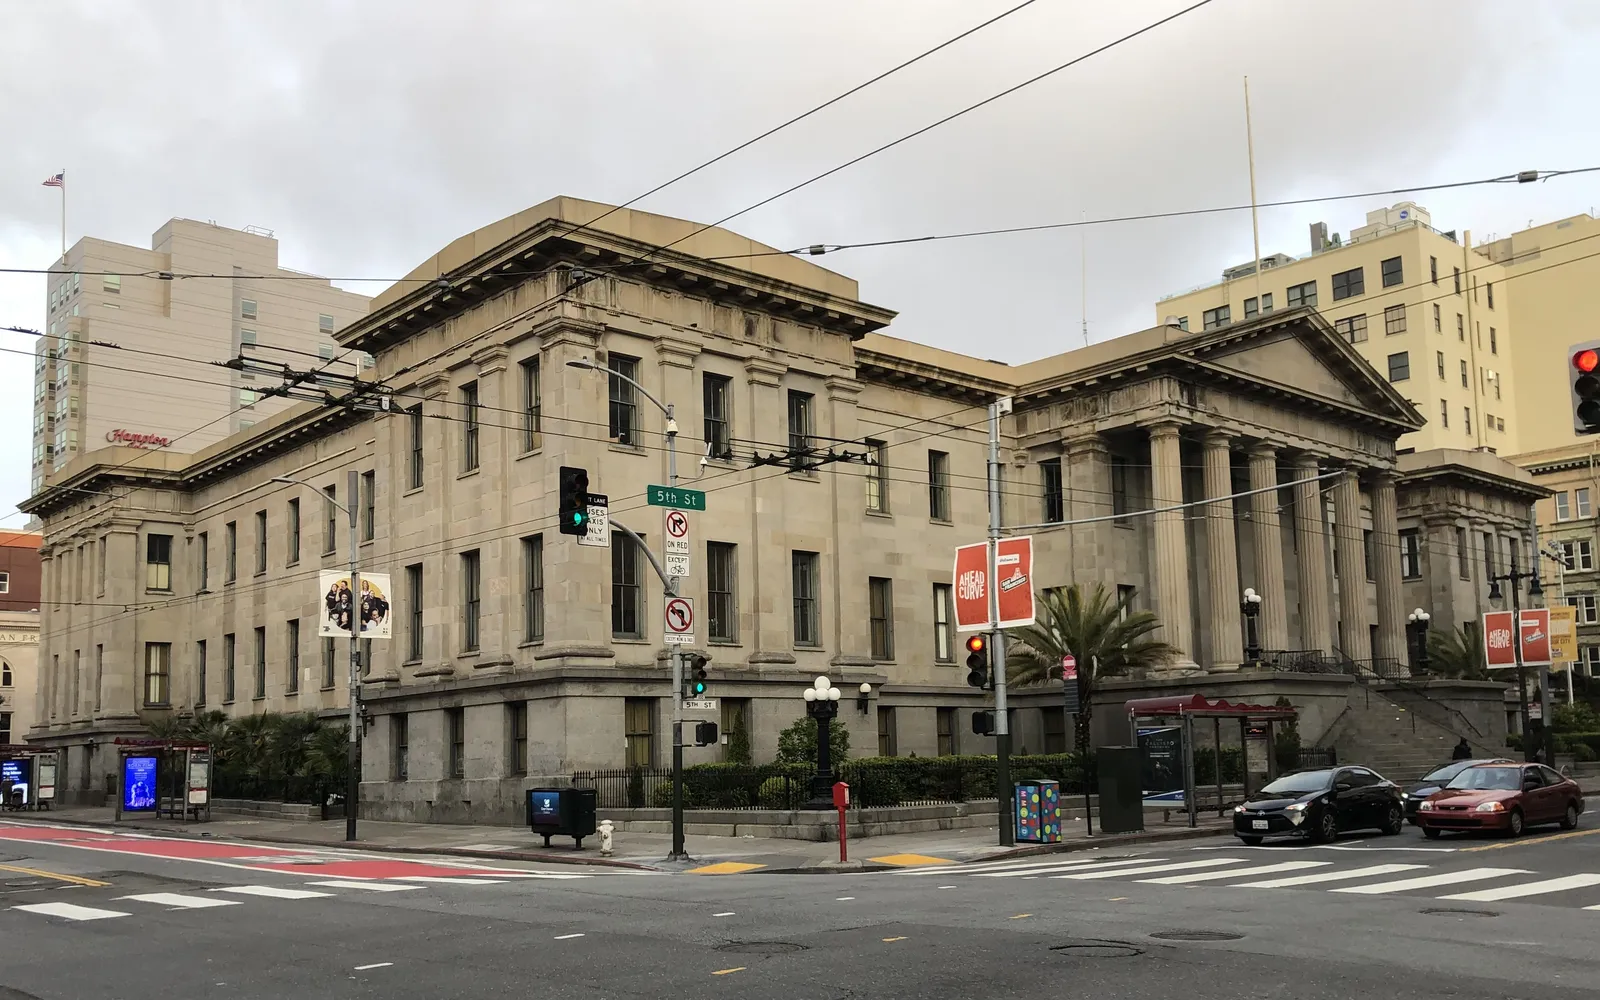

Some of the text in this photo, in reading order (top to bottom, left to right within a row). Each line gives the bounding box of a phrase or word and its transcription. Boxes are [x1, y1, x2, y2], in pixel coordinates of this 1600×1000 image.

[106, 429, 172, 447] Hampton
[657, 490, 696, 506] 5th St
[588, 508, 605, 516] USES
[588, 517, 604, 525] AXIS
[668, 540, 688, 549] ON RED
[959, 570, 985, 587] AHEAD
[959, 584, 985, 600] CURVE
[1489, 629, 1510, 640] AHEAD
[1489, 638, 1510, 648] CURVE
[686, 701, 699, 709] 5TH
